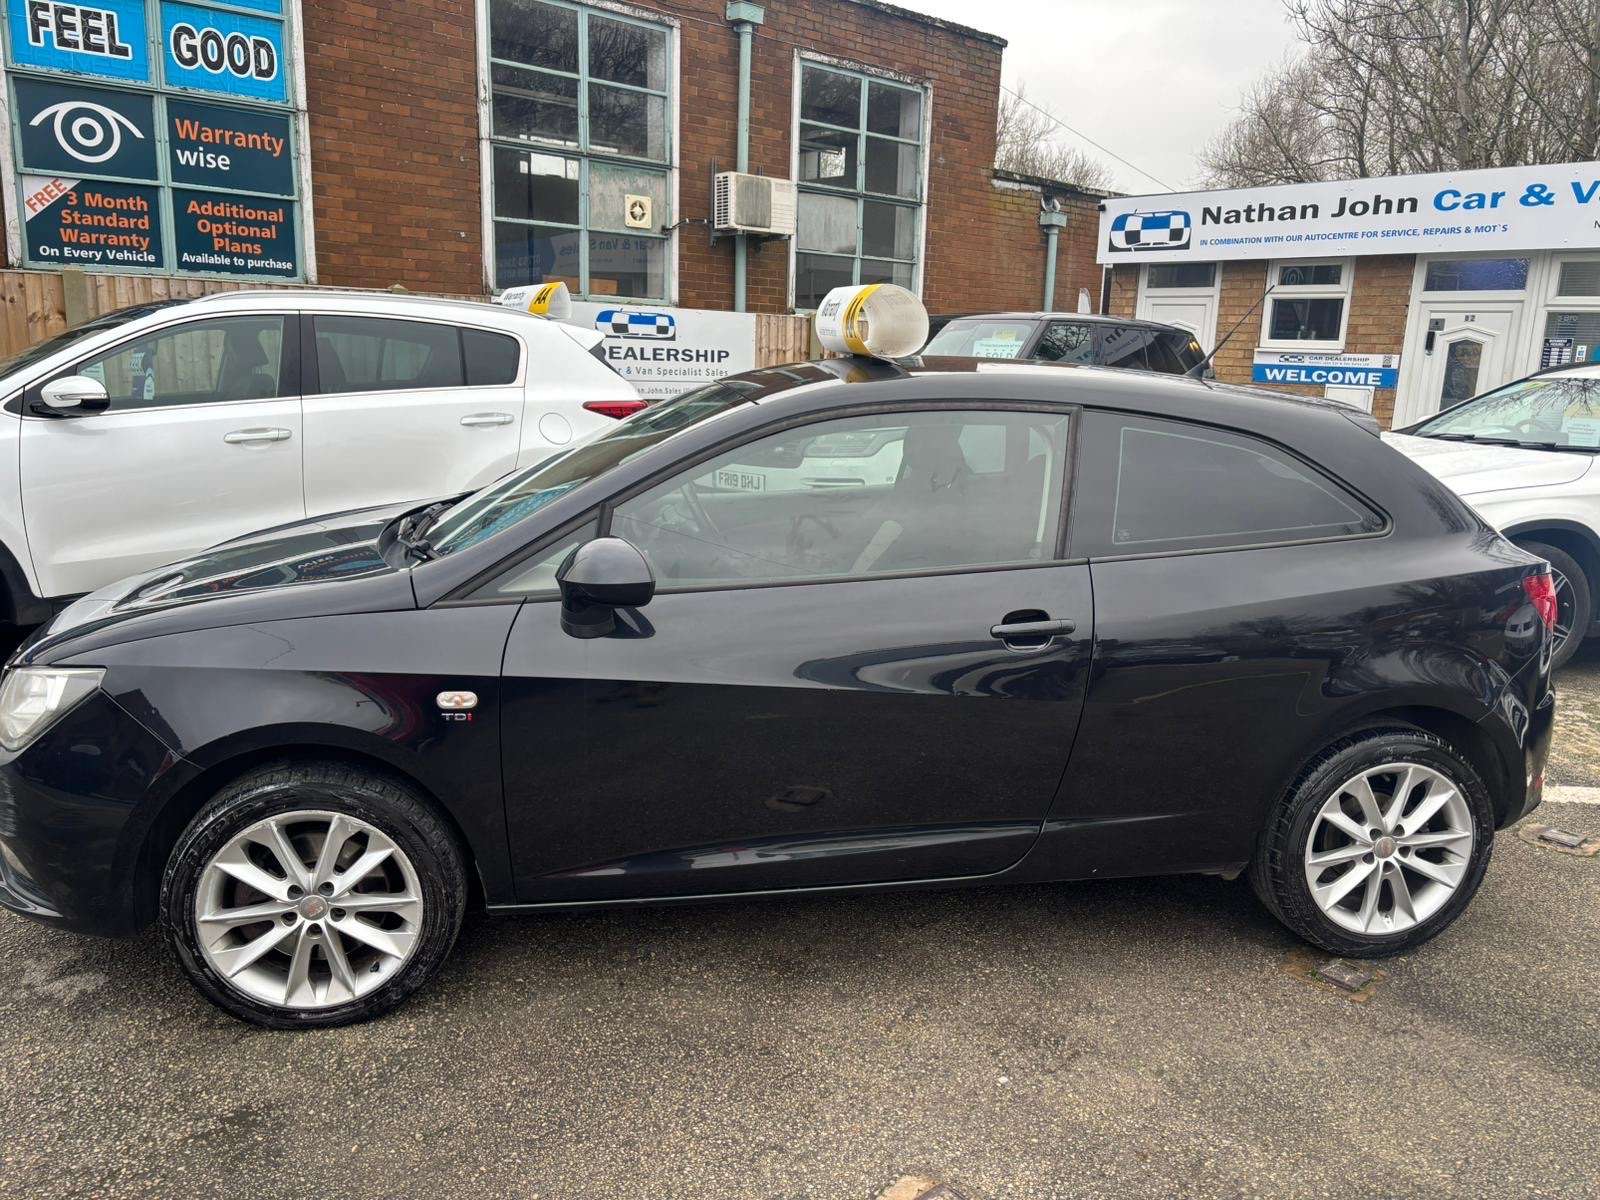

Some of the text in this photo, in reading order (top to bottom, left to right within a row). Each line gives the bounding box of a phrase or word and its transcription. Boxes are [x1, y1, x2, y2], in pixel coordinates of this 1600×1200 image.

[27, 1, 131, 58] FEEL
[172, 24, 276, 79] GOOD
[175, 118, 284, 157] Warranty
[176, 147, 231, 170] wise
[25, 178, 67, 213] FREE
[67, 191, 148, 211] 3 Month
[1201, 181, 1600, 226] Nathan John Car & V
[61, 209, 149, 230] Standard
[187, 200, 284, 222] Additional
[60, 228, 150, 250] Warranty
[197, 219, 277, 239] Optional
[1209, 237, 1262, 246] COMBINATION
[1264, 235, 1284, 244] WITH
[1286, 234, 1303, 242] OUR
[1304, 232, 1359, 241] AUTOCENTRE
[1361, 230, 1378, 239] FOR
[1381, 228, 1421, 238] SERVICE,
[1423, 226, 1462, 235] REPAIRS
[1465, 226, 1472, 234] &
[40, 245, 156, 263] On Every Vehicle
[213, 238, 263, 254] Plans
[182, 252, 293, 270] Available to purchase
[533, 287, 552, 304] AA
[636, 366, 652, 375] Van
[656, 366, 702, 377] Specialist
[705, 367, 729, 377] Sales
[1265, 368, 1383, 385] WELCOME
